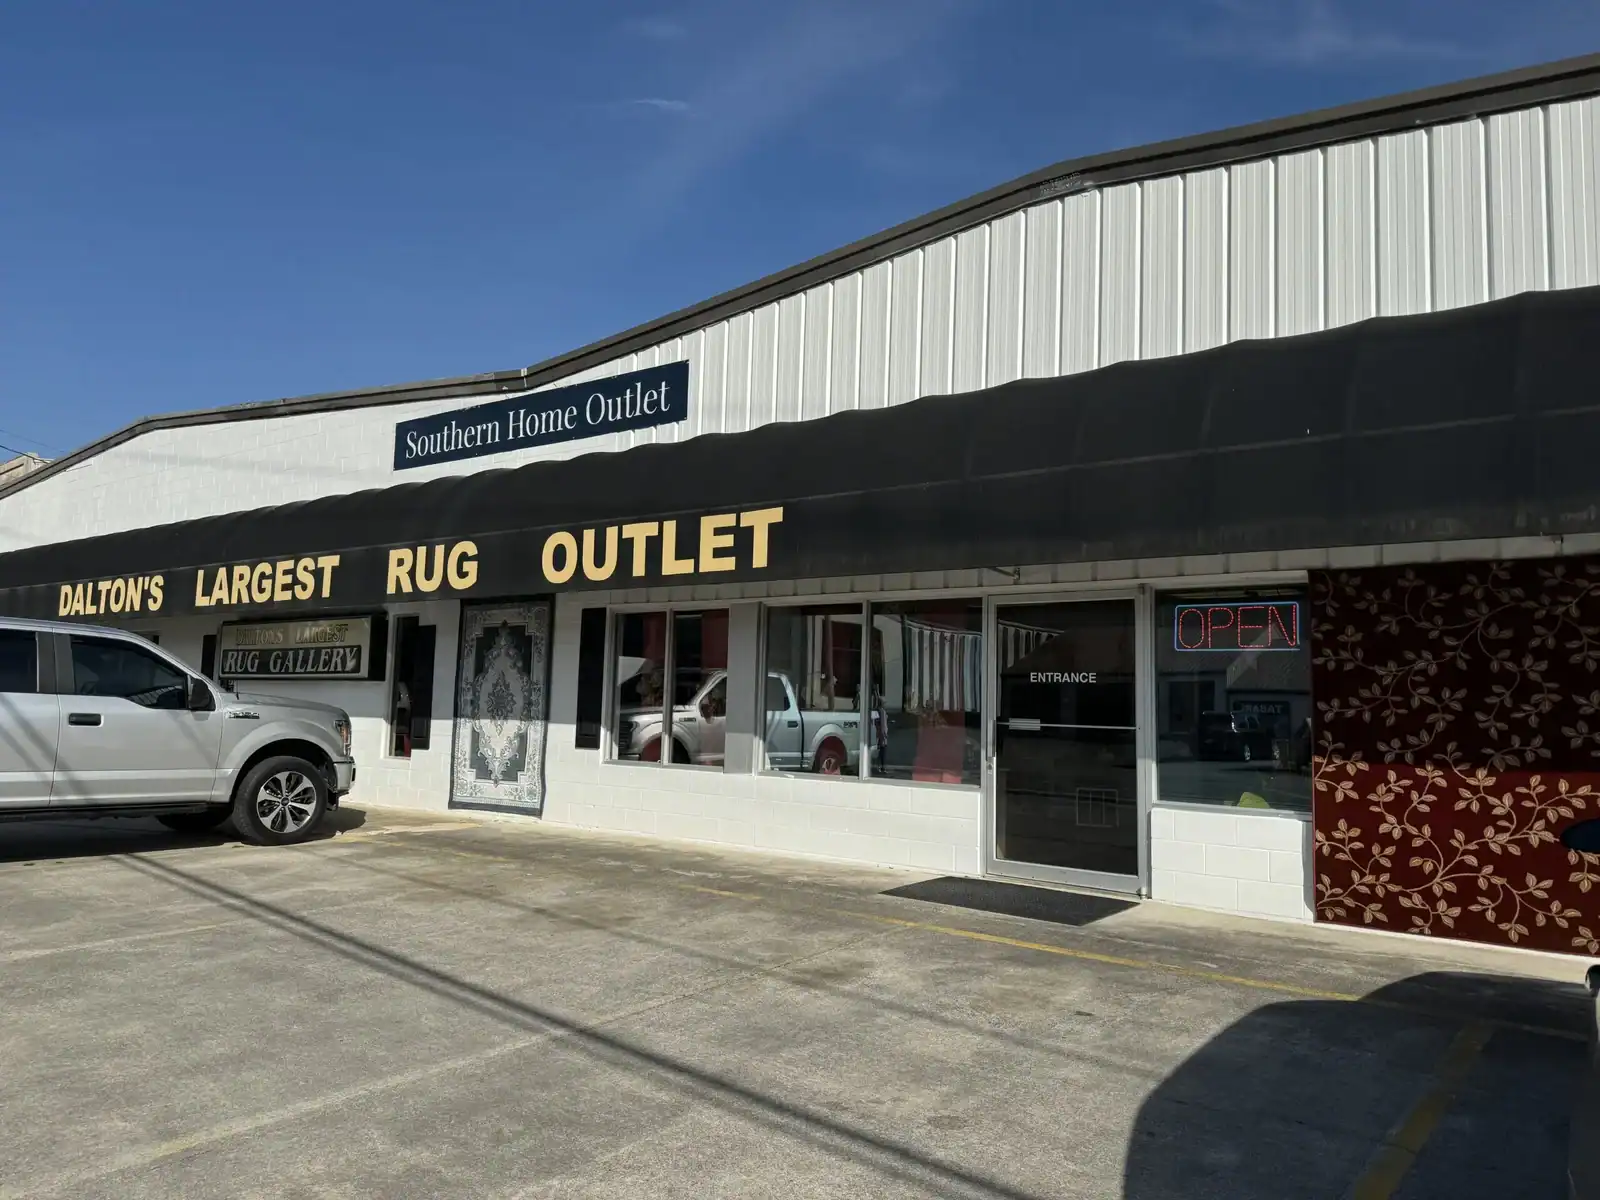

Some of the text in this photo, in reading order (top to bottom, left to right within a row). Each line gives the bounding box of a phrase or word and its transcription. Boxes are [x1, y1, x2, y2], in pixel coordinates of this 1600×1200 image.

[405, 380, 671, 459] Southern Home Outlet
[58, 506, 784, 616] DALTON'S LARGEST RUG OUTLET
[1178, 604, 1297, 649] OPEN
[223, 647, 358, 673] RUG GALLERY
[1029, 672, 1097, 684] ENTRANCE
